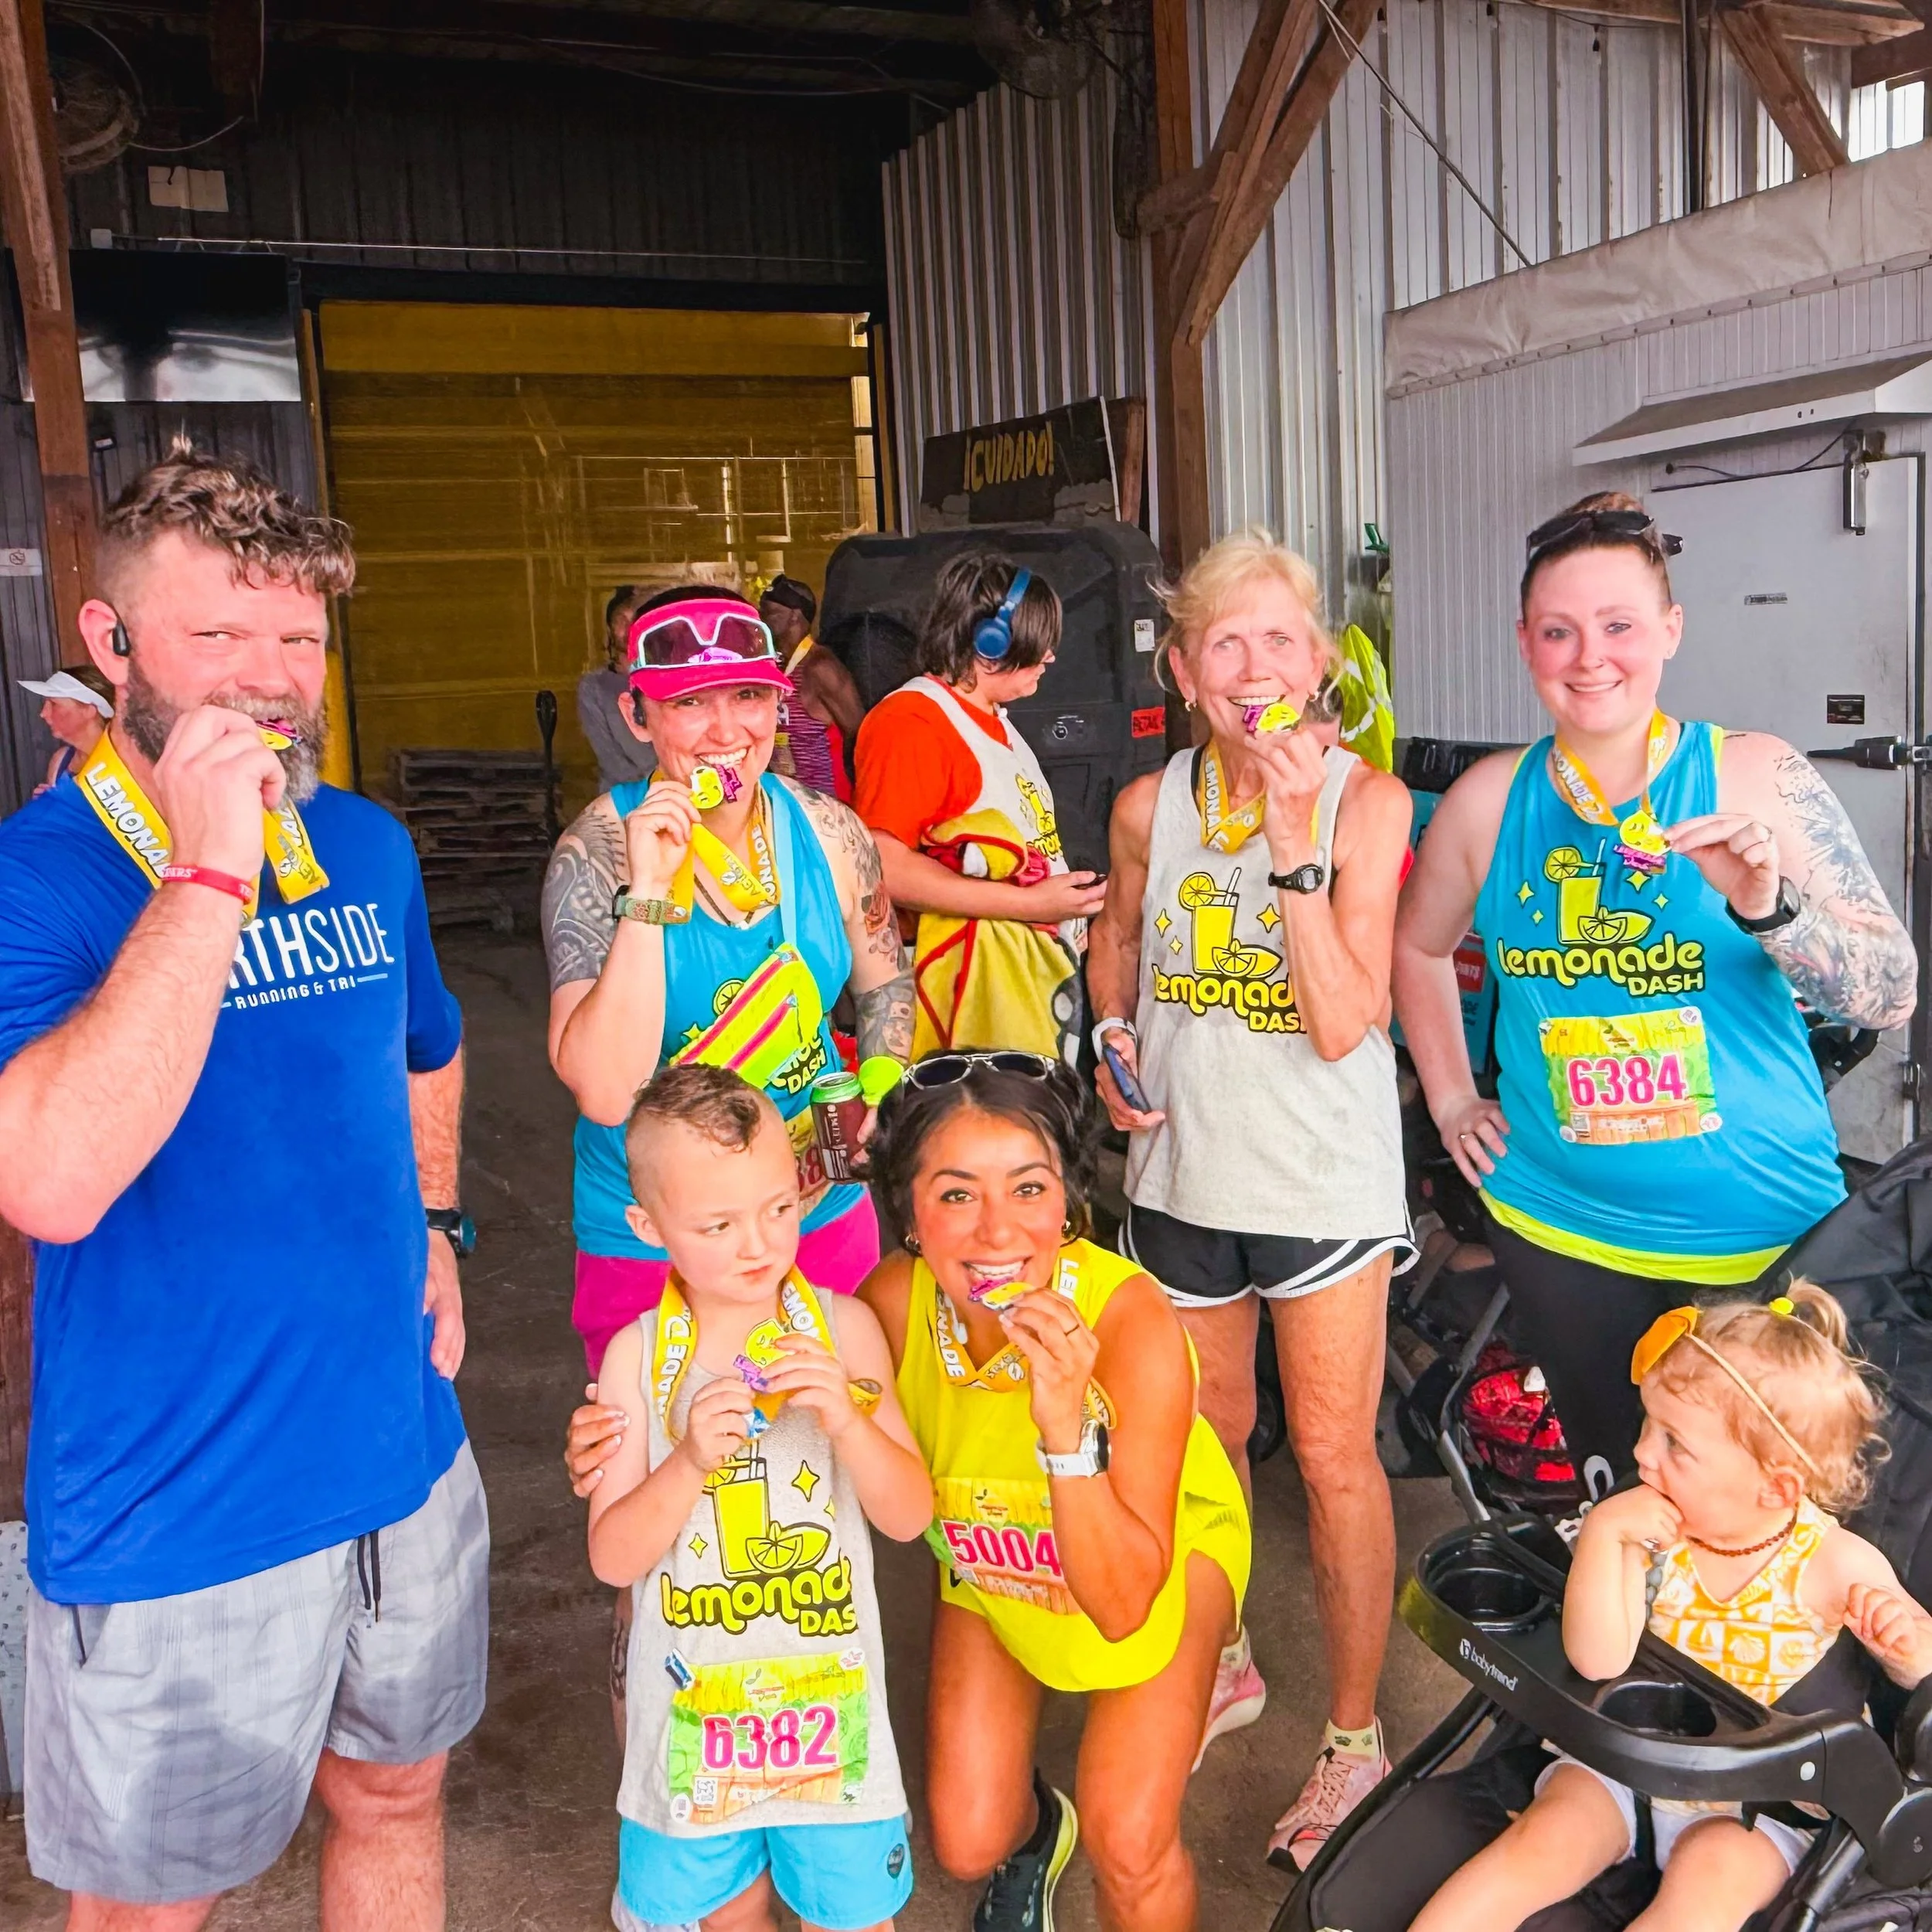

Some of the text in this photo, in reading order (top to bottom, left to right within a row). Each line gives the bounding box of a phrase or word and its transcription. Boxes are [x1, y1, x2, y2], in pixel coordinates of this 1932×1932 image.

[1497, 933, 1704, 987] lemonade
[1627, 971, 1704, 997] DASH
[234, 975, 356, 1010] RUNNING & TRI
[787, 1047, 827, 1094] DASH
[1567, 1053, 1688, 1107] 6384
[942, 1521, 1063, 1577] 5004
[704, 1705, 837, 1769] 6382
